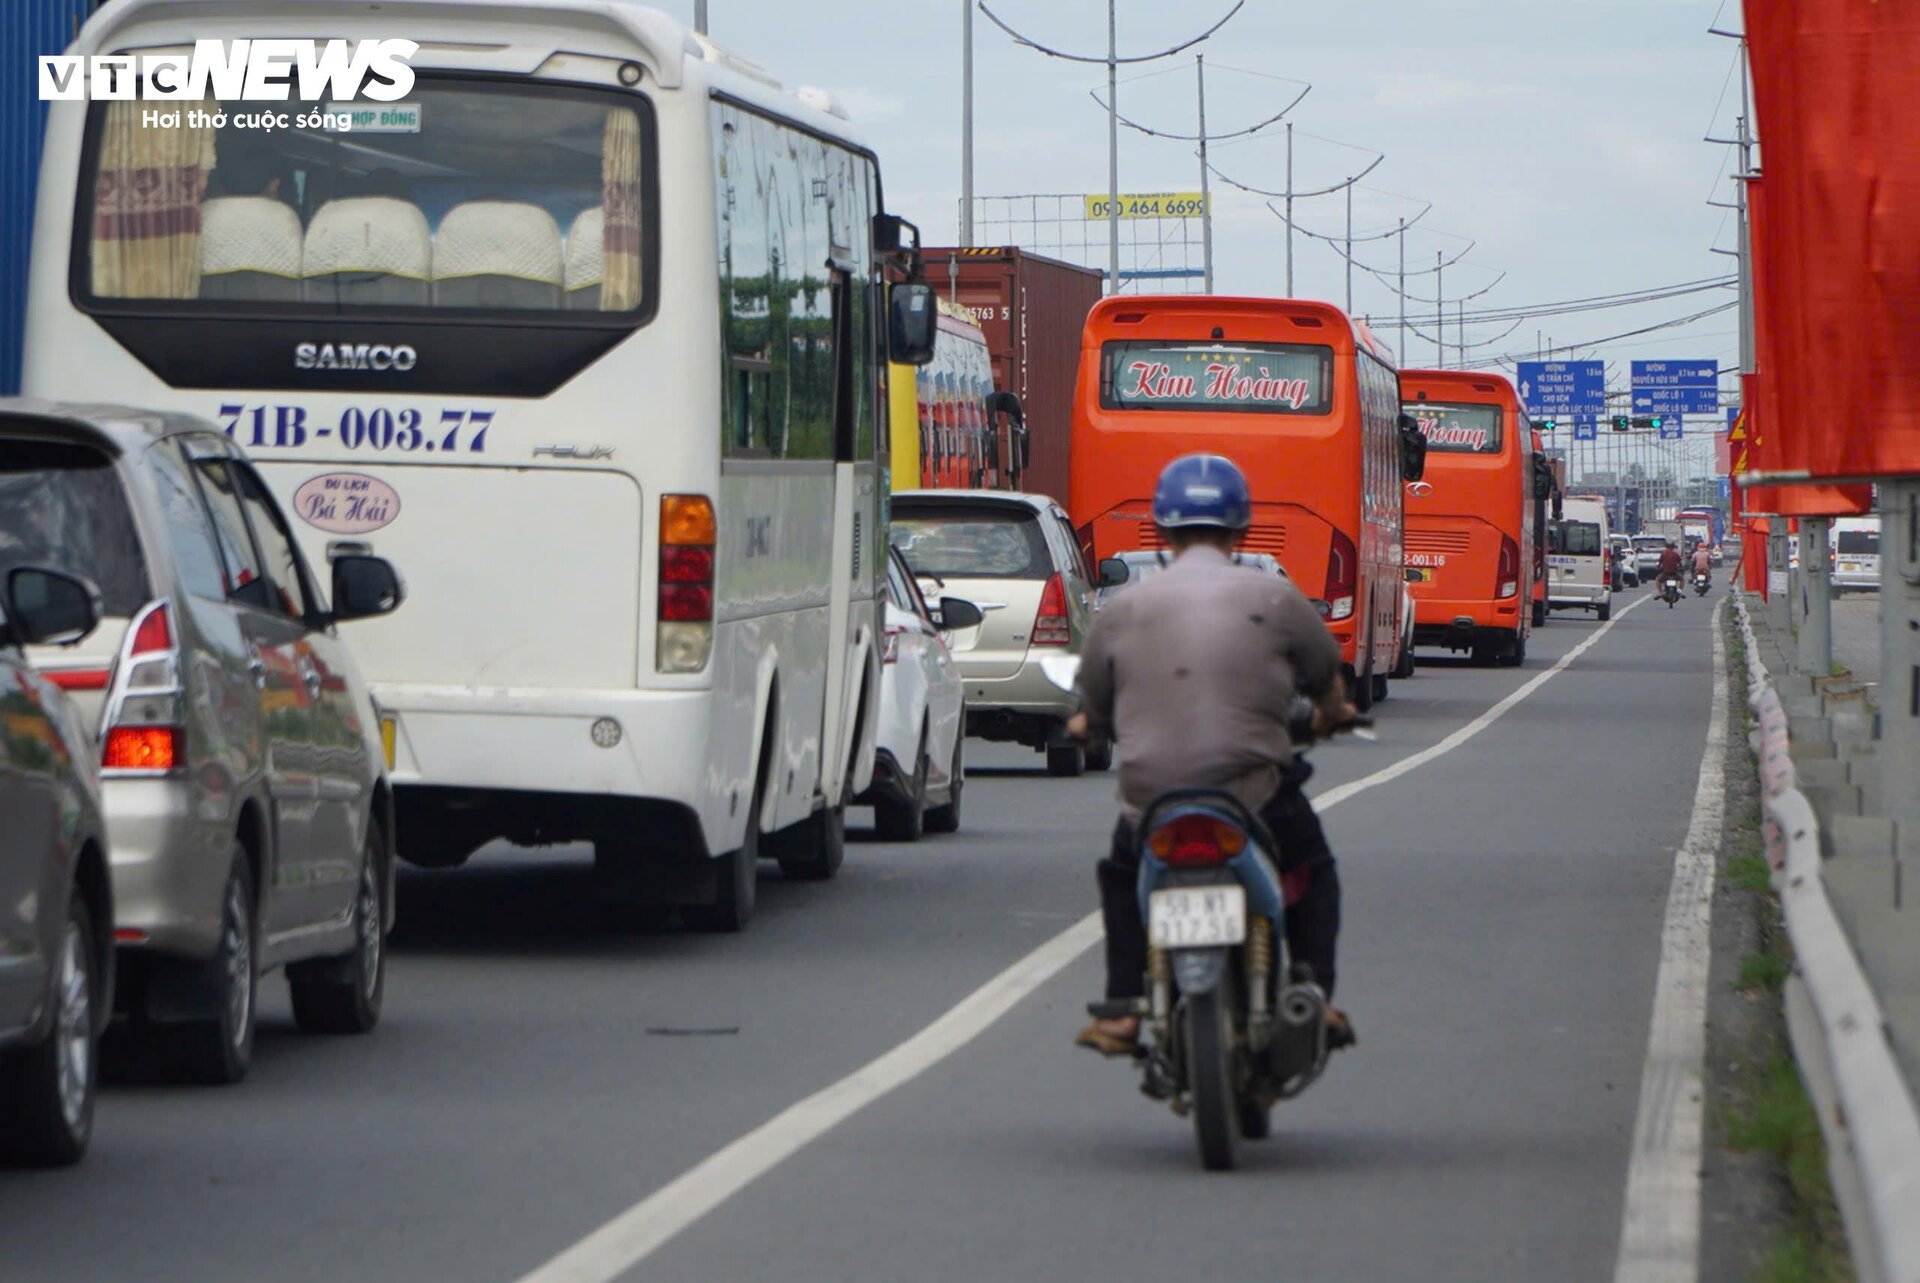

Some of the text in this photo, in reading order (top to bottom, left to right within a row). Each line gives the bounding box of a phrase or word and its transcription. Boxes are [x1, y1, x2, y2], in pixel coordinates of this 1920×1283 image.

[1092, 199, 1203, 217] 090 464 6699
[295, 343, 417, 371] SAMCO
[1123, 361, 1310, 410] Kim Hoàng
[325, 479, 341, 490] DU
